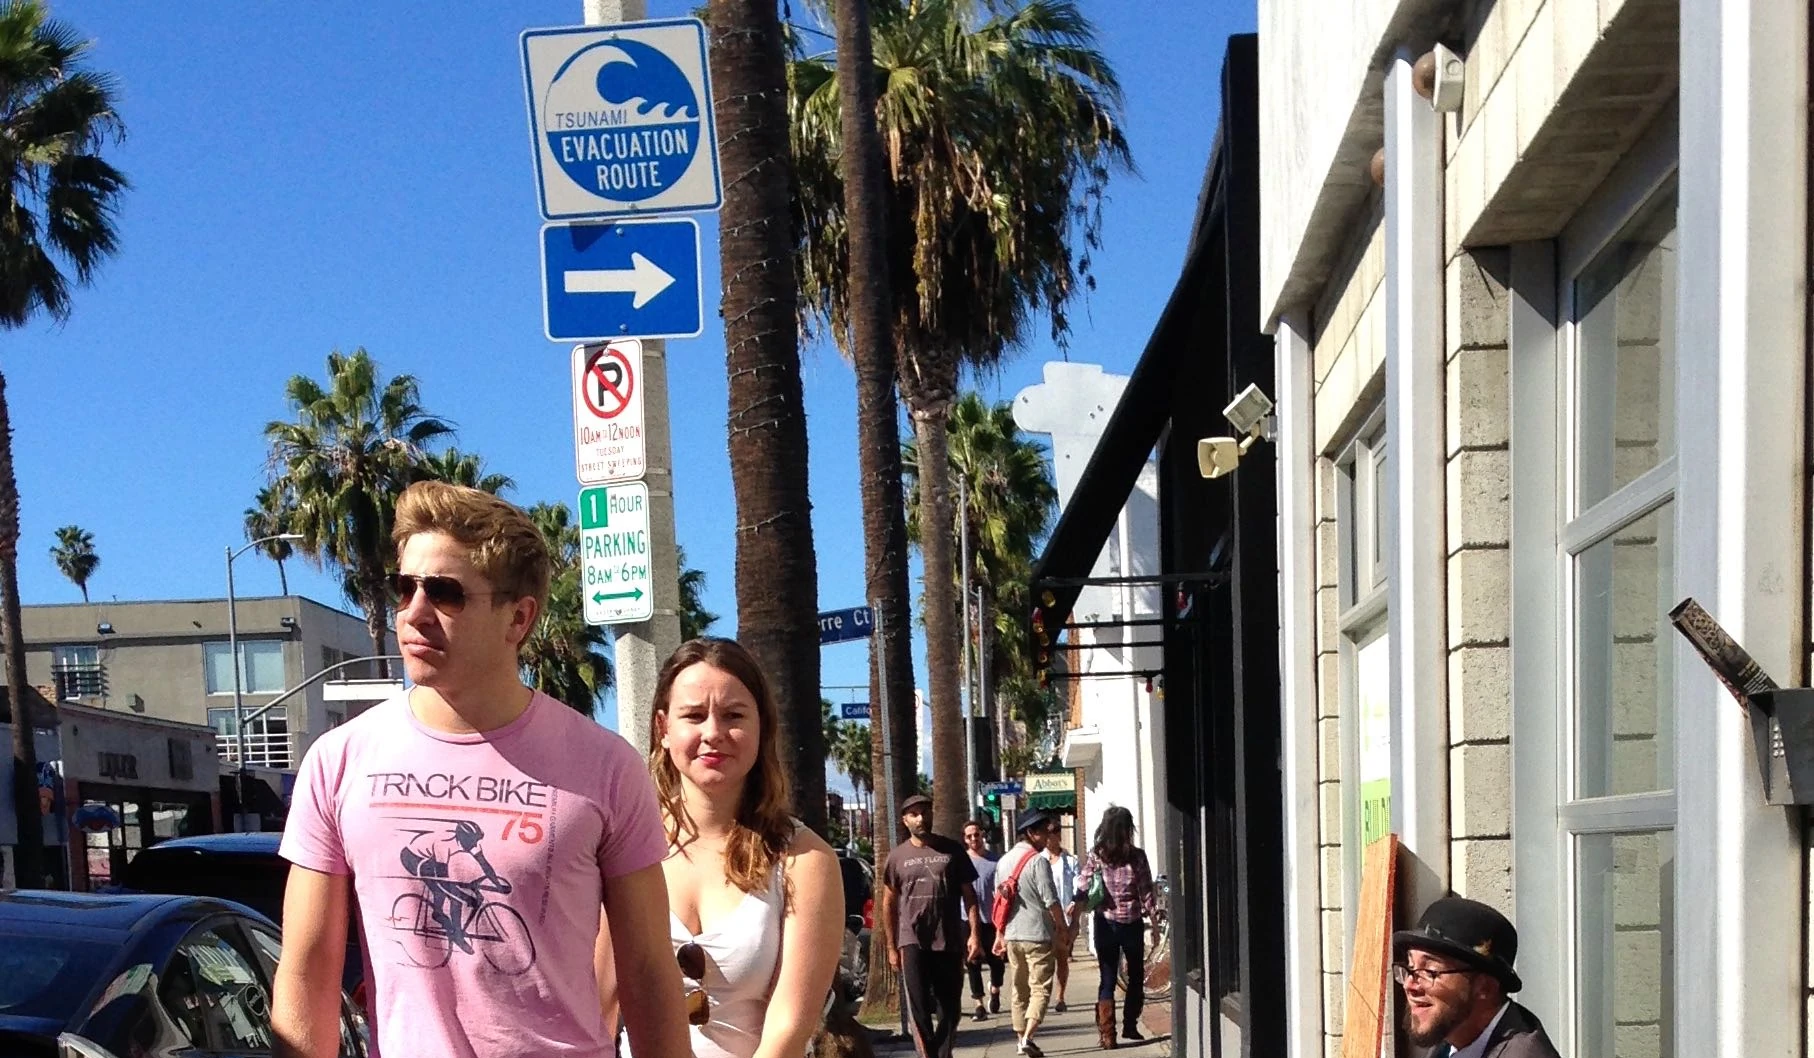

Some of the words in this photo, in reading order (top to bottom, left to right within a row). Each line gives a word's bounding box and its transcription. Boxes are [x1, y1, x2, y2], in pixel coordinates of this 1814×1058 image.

[555, 109, 628, 129] TSUNAMI
[561, 128, 689, 162] EVACUATION
[596, 160, 662, 191] ROUTE
[580, 426, 601, 445] 10AM
[607, 422, 641, 441] 12NOON
[596, 445, 625, 456] TUESDAY
[581, 461, 604, 472] STREET
[590, 494, 598, 523] 1
[610, 493, 643, 514] HOUR
[585, 529, 646, 559] PARKING
[587, 565, 613, 585] 8AM
[621, 562, 647, 582] 6PM
[817, 616, 843, 631] rre
[853, 609, 870, 626] Ct
[367, 773, 473, 800] TRACK
[476, 776, 548, 808] BIKE
[500, 811, 544, 844] 75
